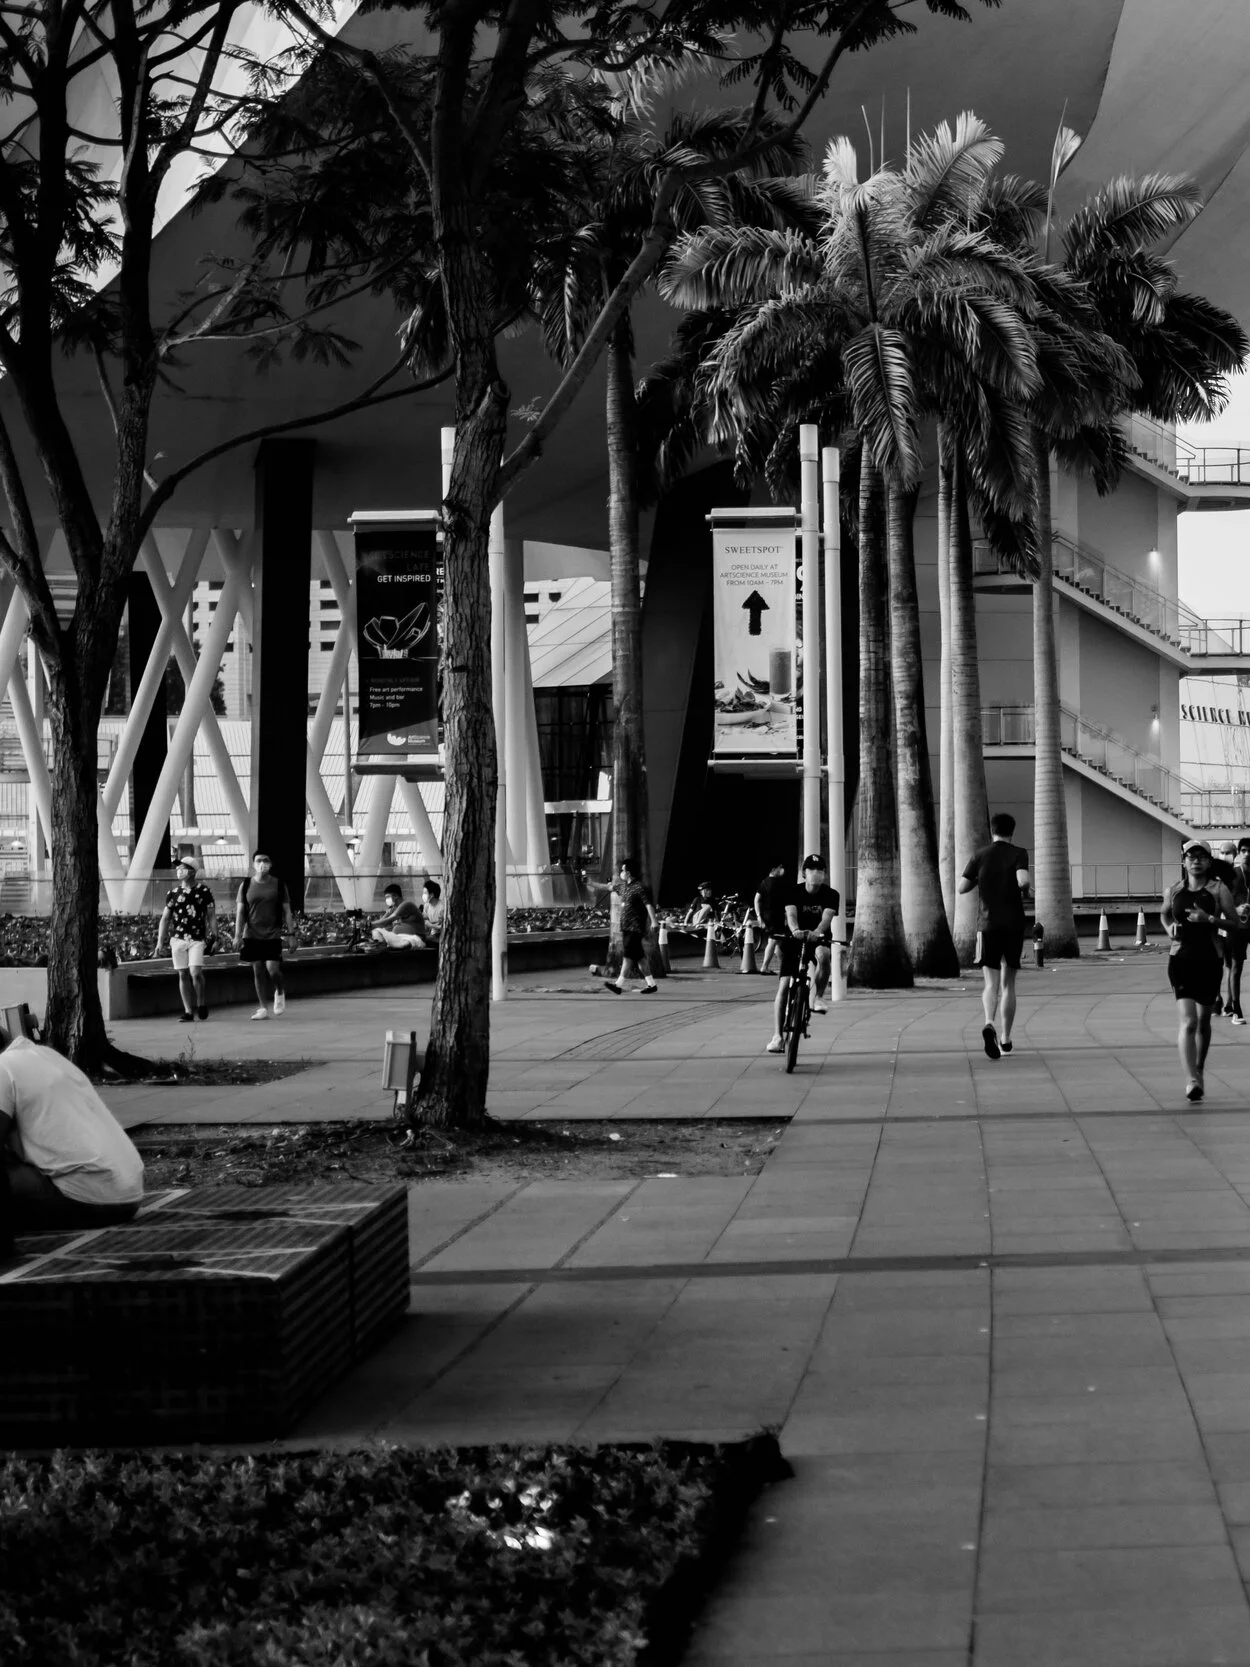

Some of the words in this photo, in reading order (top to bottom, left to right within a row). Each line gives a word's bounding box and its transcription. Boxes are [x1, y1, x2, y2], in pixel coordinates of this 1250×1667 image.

[724, 545, 781, 554] SWEETSPOT
[377, 574, 392, 583] GET
[394, 574, 431, 583] INSPIRED
[390, 686, 423, 694] performance
